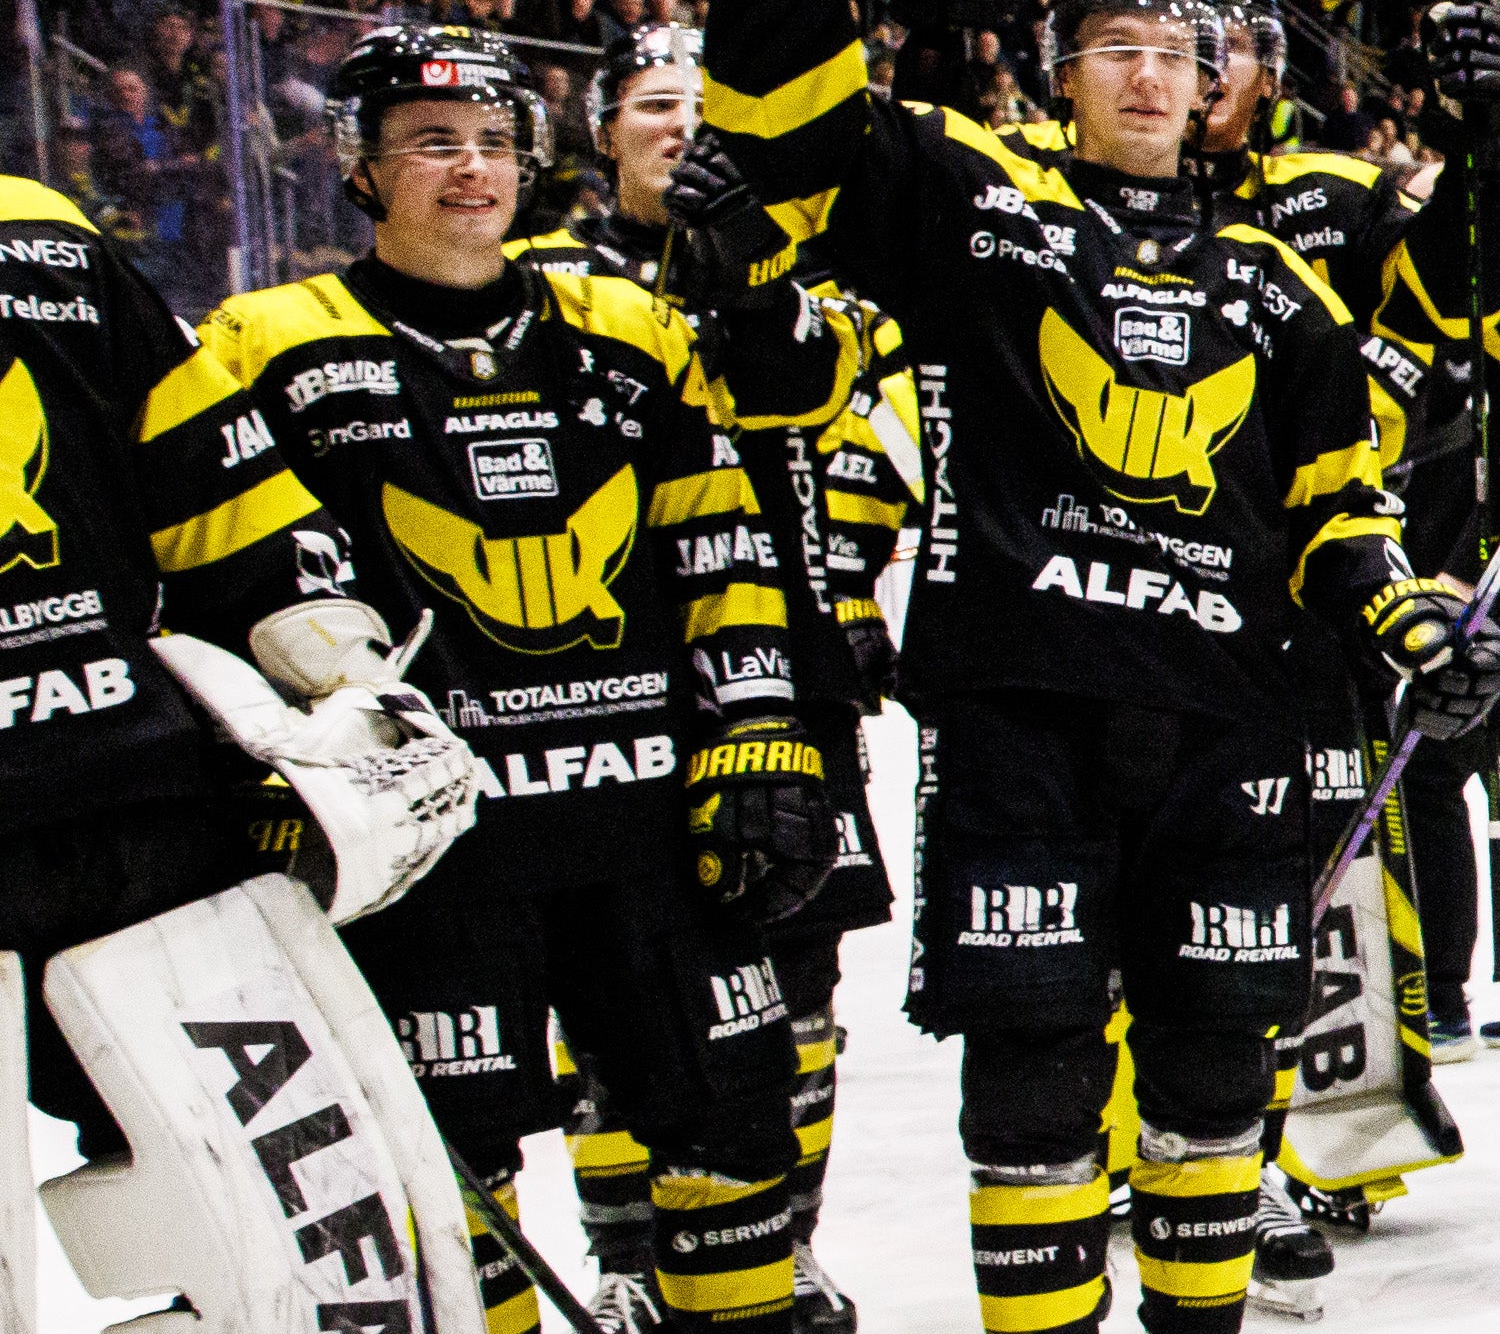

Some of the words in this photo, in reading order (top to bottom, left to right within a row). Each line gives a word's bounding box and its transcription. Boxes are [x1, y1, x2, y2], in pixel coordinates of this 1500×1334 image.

[479, 469, 554, 494] Värme
[920, 365, 956, 584] HITACHI
[1032, 554, 1243, 634] ALFAB
[489, 670, 670, 714] TOTALBYGGEN
[957, 930, 1011, 947] ROAD
[1015, 926, 1085, 948] RENTAL
[1178, 943, 1231, 963] ROAD
[1234, 946, 1301, 963] RENTAL
[430, 1054, 518, 1078] RENTAL
